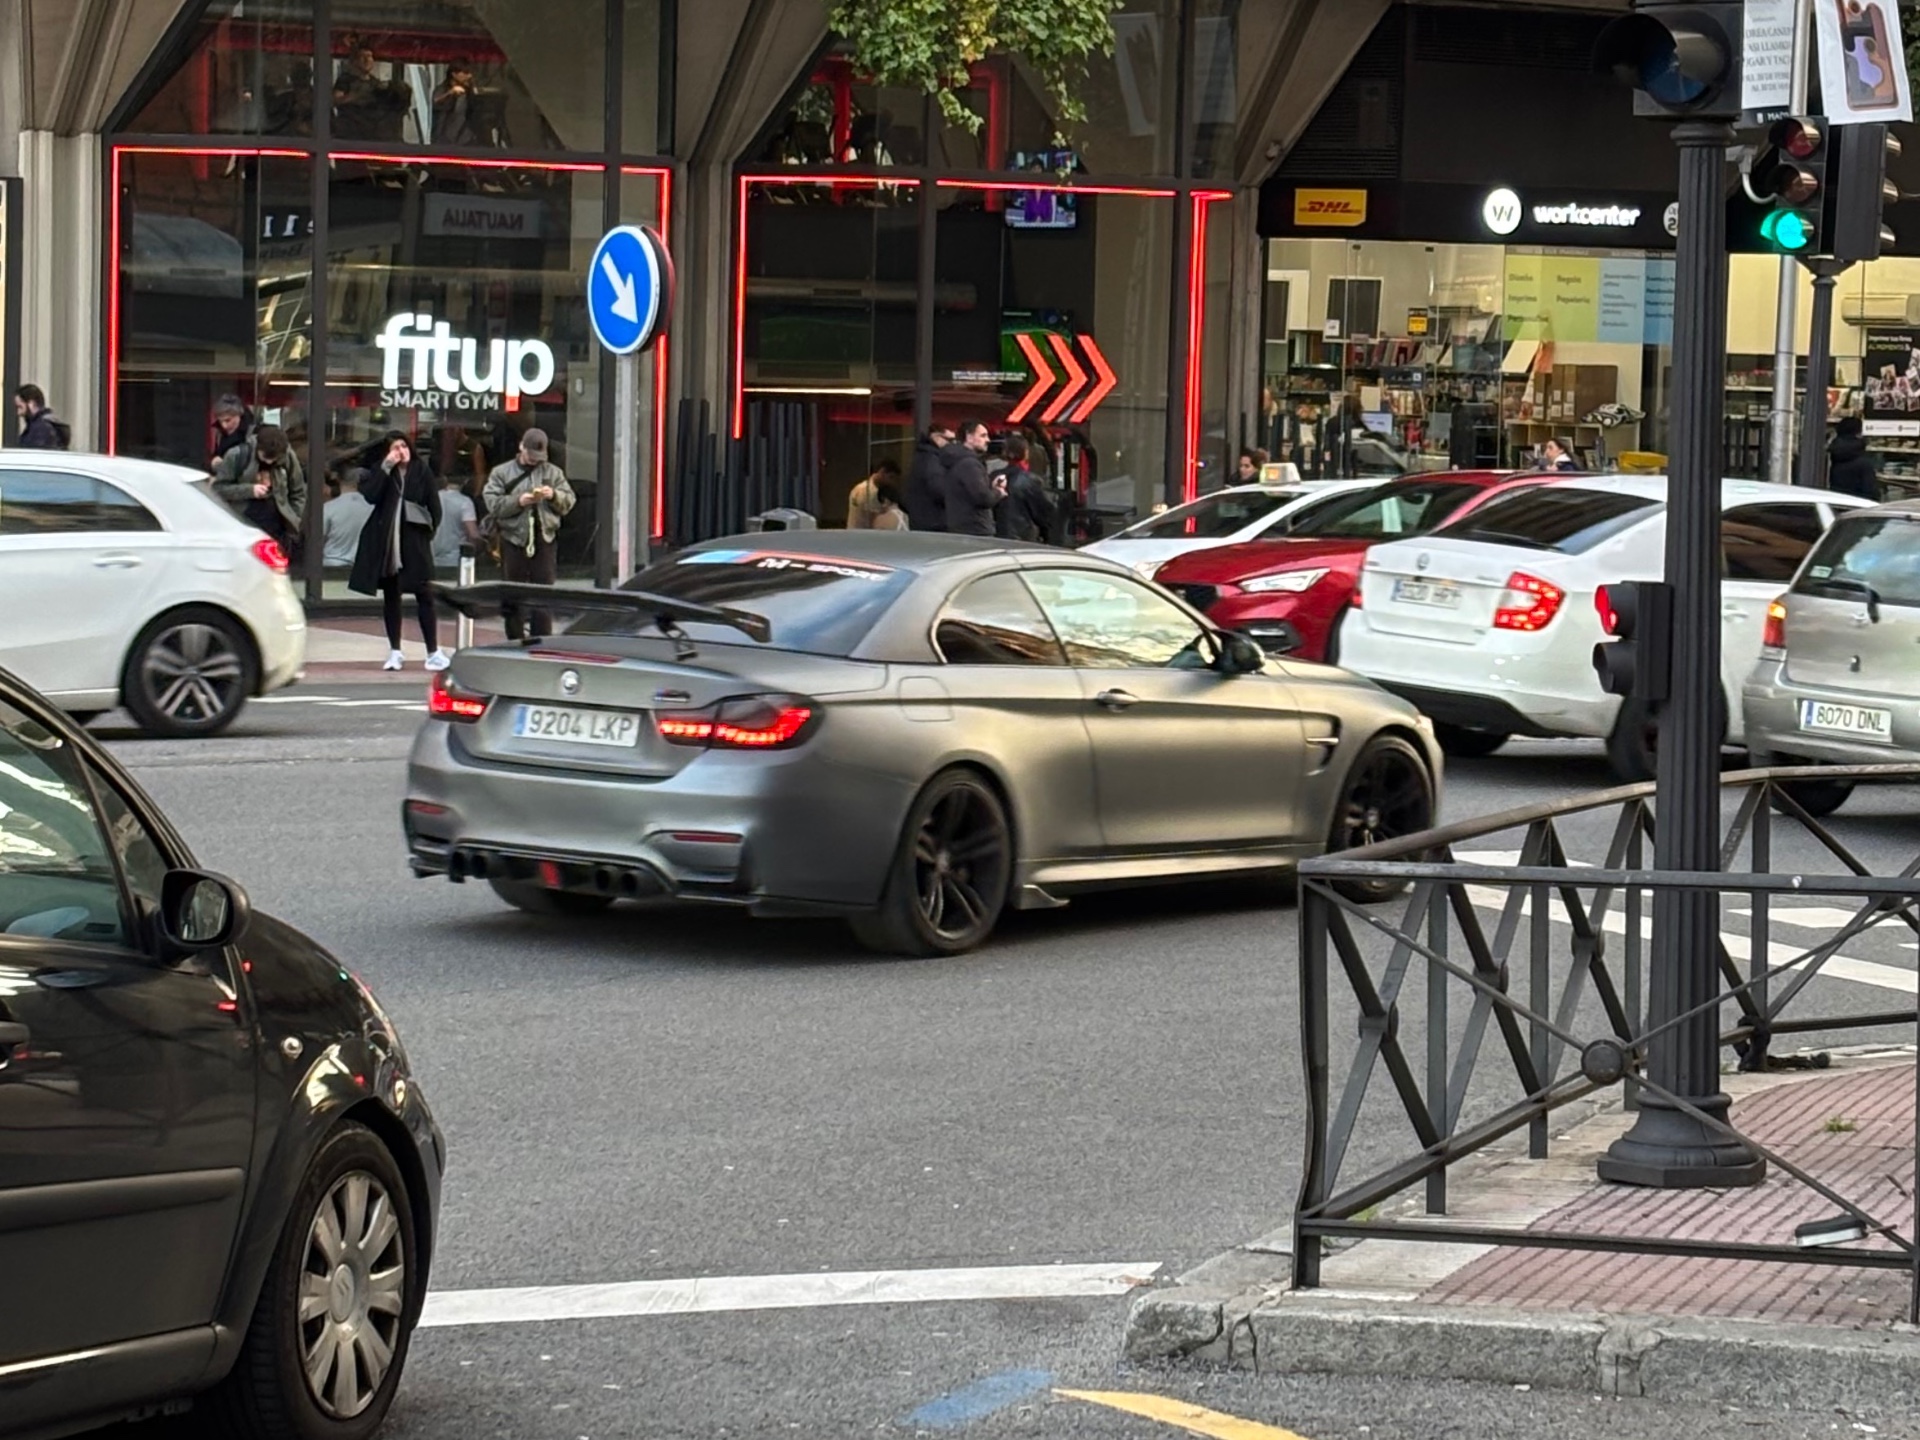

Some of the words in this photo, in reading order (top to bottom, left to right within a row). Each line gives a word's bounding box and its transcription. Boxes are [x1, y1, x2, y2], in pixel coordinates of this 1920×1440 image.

[1307, 200, 1352, 213] DHL
[1532, 202, 1641, 227] workcenter
[375, 312, 555, 412] fitup
[379, 390, 451, 409] SMART
[455, 391, 499, 410] GYM
[529, 709, 582, 738] 9204
[589, 711, 633, 742] LKP
[1816, 706, 1854, 728] 8070
[1857, 709, 1885, 733] DNL
